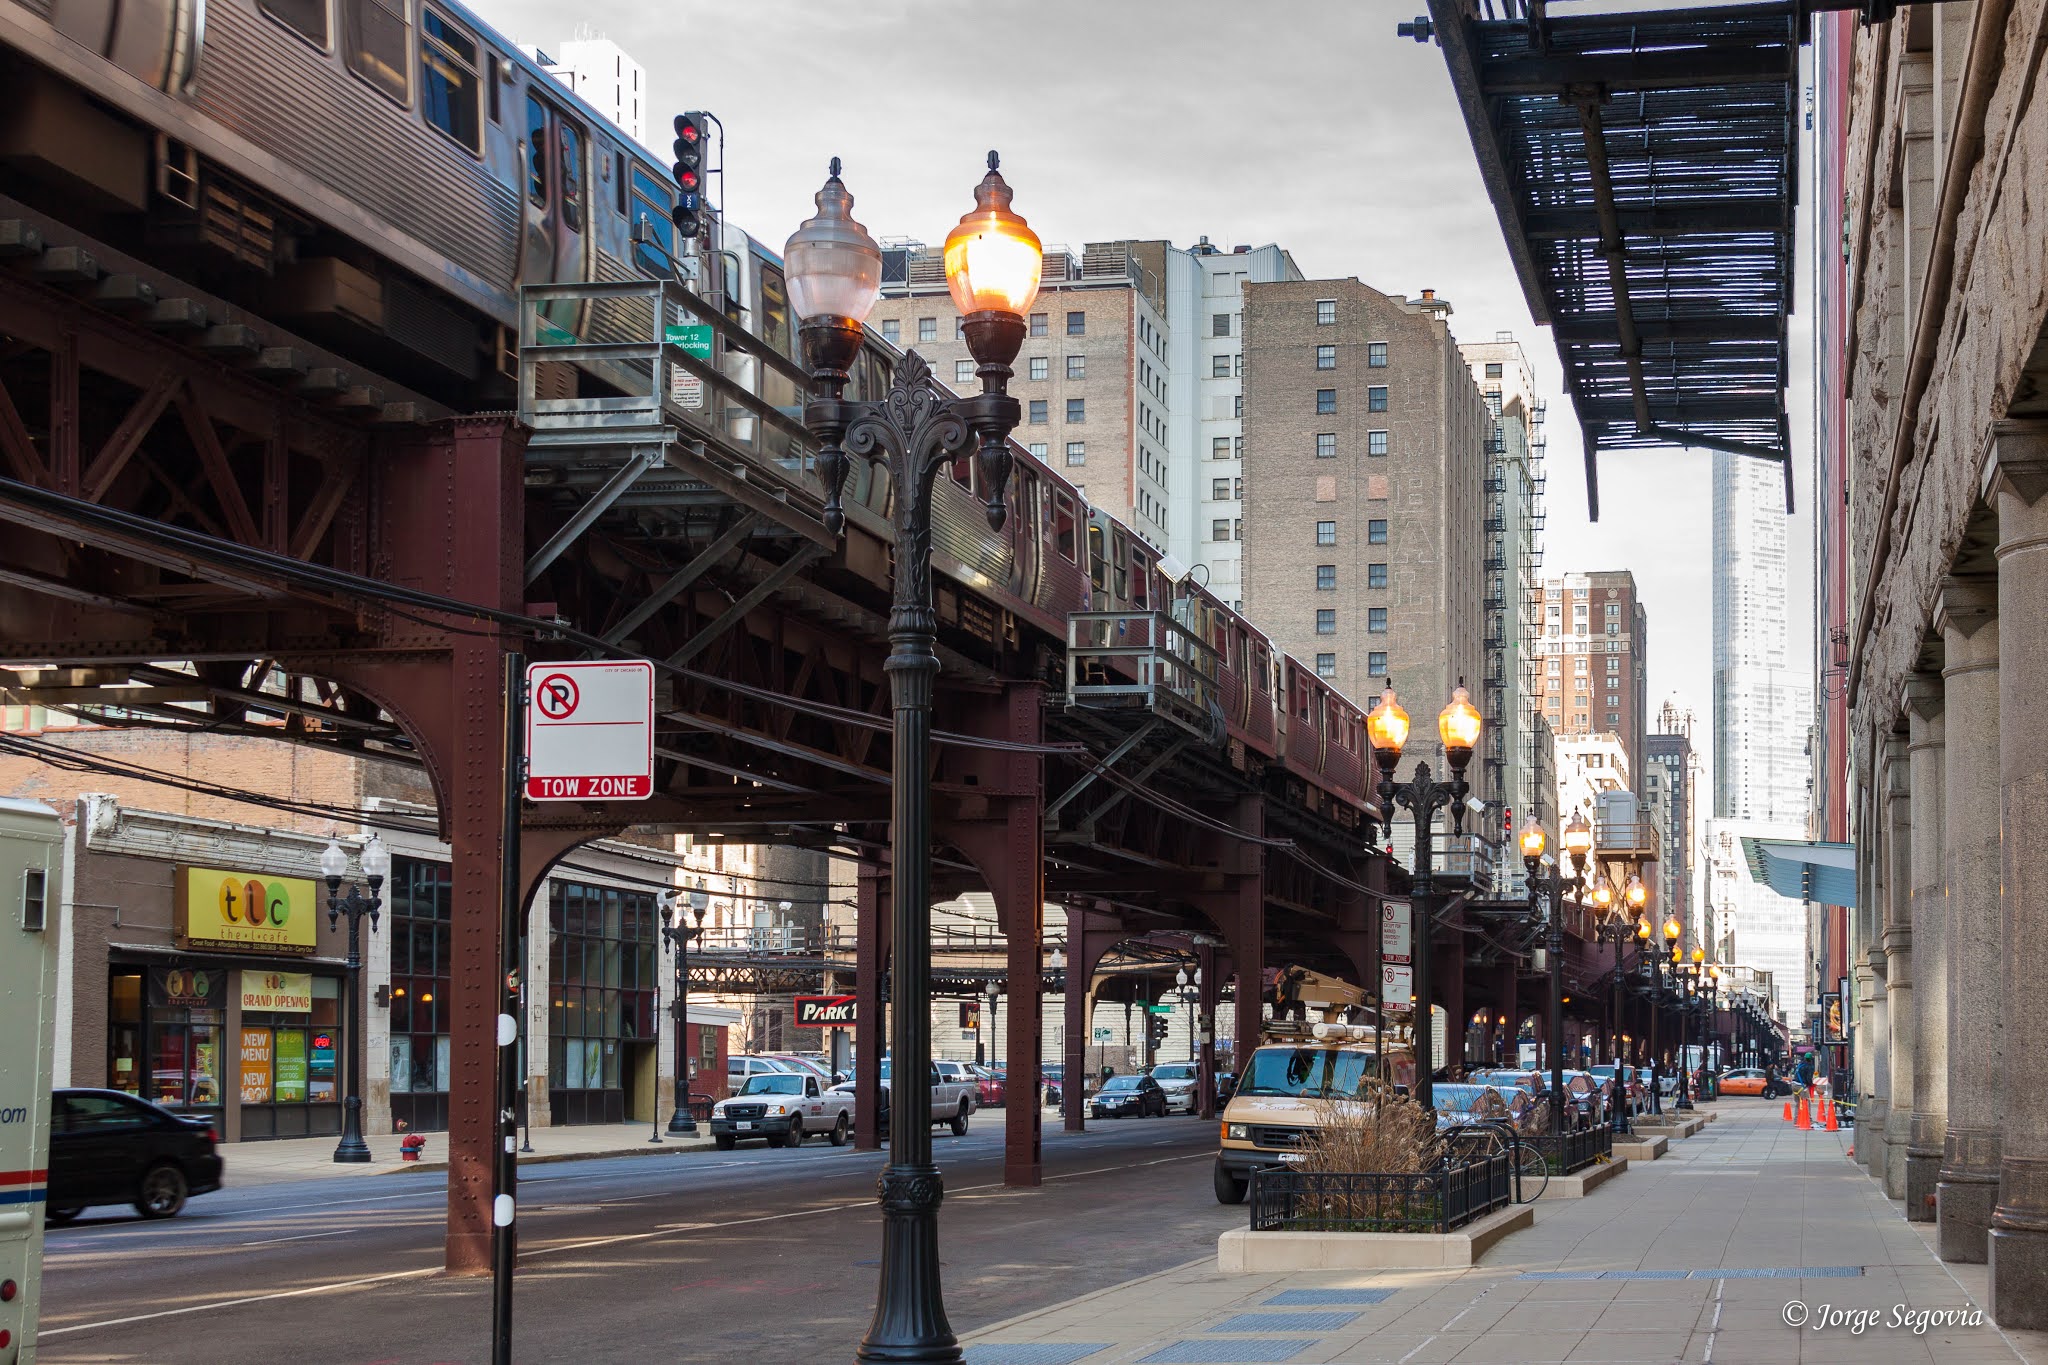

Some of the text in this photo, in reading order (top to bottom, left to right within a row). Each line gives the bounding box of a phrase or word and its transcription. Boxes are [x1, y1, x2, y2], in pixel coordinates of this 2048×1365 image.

[666, 333, 688, 341] Tower
[541, 777, 637, 796] TOW ZONE
[225, 884, 283, 925] tlc
[243, 993, 309, 1009] GRAND OPENING
[802, 1003, 849, 1020] PARK
[243, 1033, 267, 1047] NEW
[315, 1037, 330, 1047] OPEN
[241, 1048, 269, 1062] MENU
[243, 1072, 266, 1086] NEW
[240, 1087, 269, 1101] LOOK
[0, 1107, 27, 1124] om
